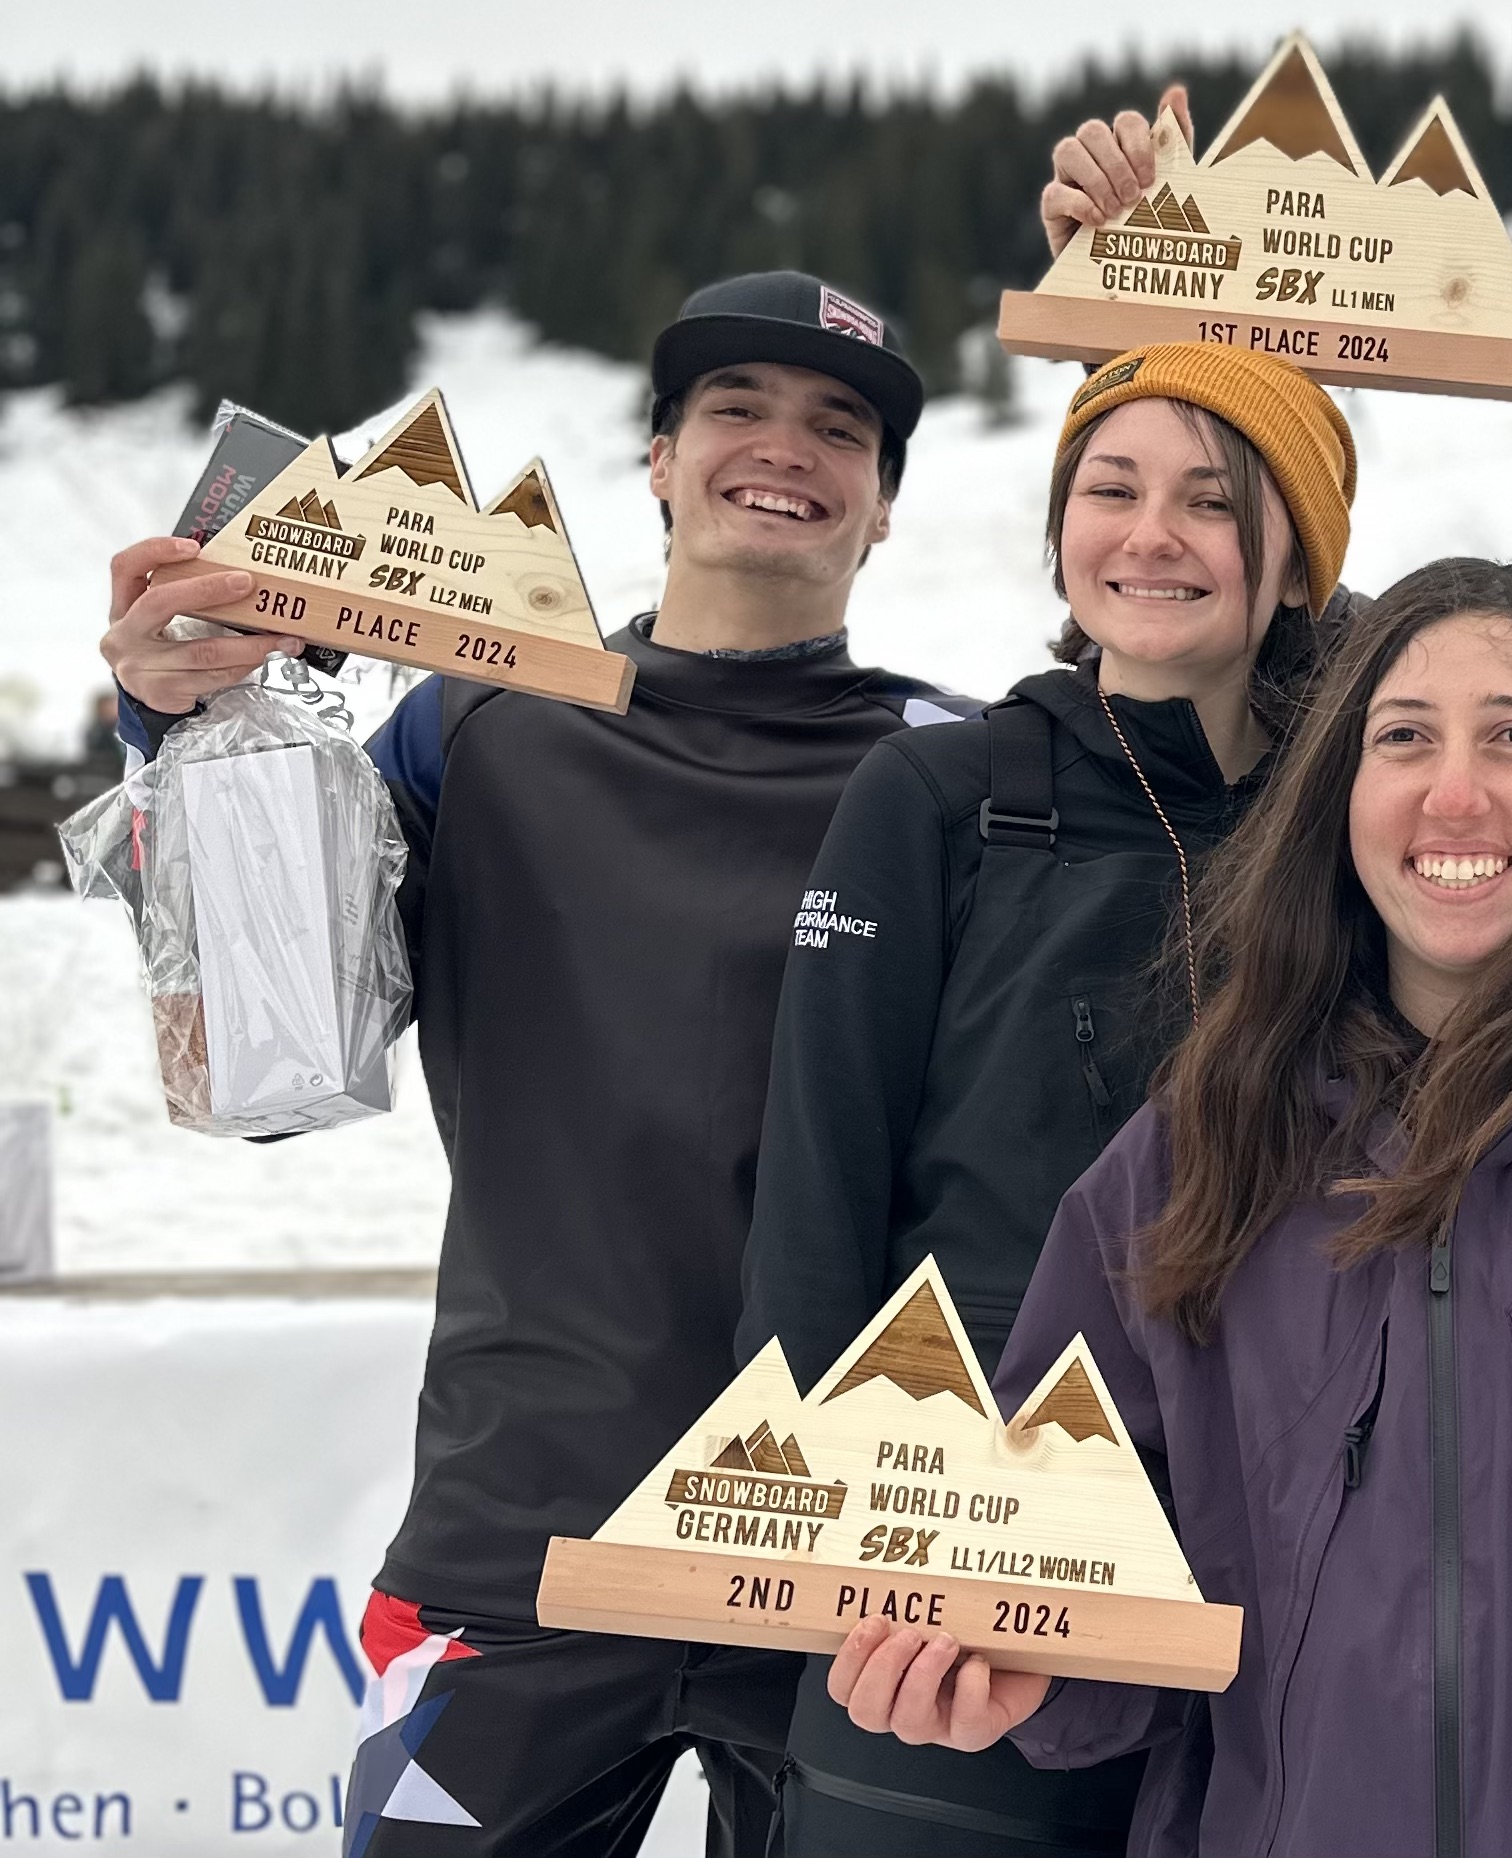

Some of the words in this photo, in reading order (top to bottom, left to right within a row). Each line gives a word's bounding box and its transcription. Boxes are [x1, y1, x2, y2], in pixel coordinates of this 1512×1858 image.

[1266, 188, 1326, 219] PARA
[1105, 233, 1227, 266] SNOWBOARD
[1263, 228, 1341, 260] WORLD
[1349, 236, 1394, 264] CUP
[1102, 263, 1225, 300] GERMANY
[1255, 266, 1326, 306] SBX
[1331, 288, 1358, 309] LL1
[1361, 291, 1396, 312] MEN
[1198, 321, 1238, 346] 1ST
[1250, 326, 1320, 356] PLACE
[1337, 334, 1389, 363] 2024
[257, 520, 354, 556] SNOWBOARD
[386, 506, 435, 536] PARA
[250, 541, 349, 581] GERMANY
[380, 533, 444, 565] WORLD
[448, 549, 486, 574] CUP
[368, 563, 426, 597] SBX
[429, 585, 458, 608] LL2
[458, 592, 493, 615] MEN
[255, 589, 307, 621] 3RD
[335, 606, 421, 647] PLACE
[454, 634, 517, 669] 2024
[800, 890, 838, 912] HIGH
[794, 929, 829, 949] TEAM
[876, 1441, 945, 1475] PARA
[684, 1475, 829, 1514] SNOWBOARD
[869, 1482, 960, 1519] WORLD
[968, 1493, 1020, 1525] CUP
[676, 1509, 824, 1552] GERMANY
[858, 1524, 941, 1567] SBX
[950, 1546, 1035, 1578] LL1/LL2
[1039, 1555, 1116, 1586] WOMEN
[726, 1575, 796, 1612] 2ND
[836, 1584, 946, 1626] PLACE
[992, 1600, 1071, 1639] 2024
